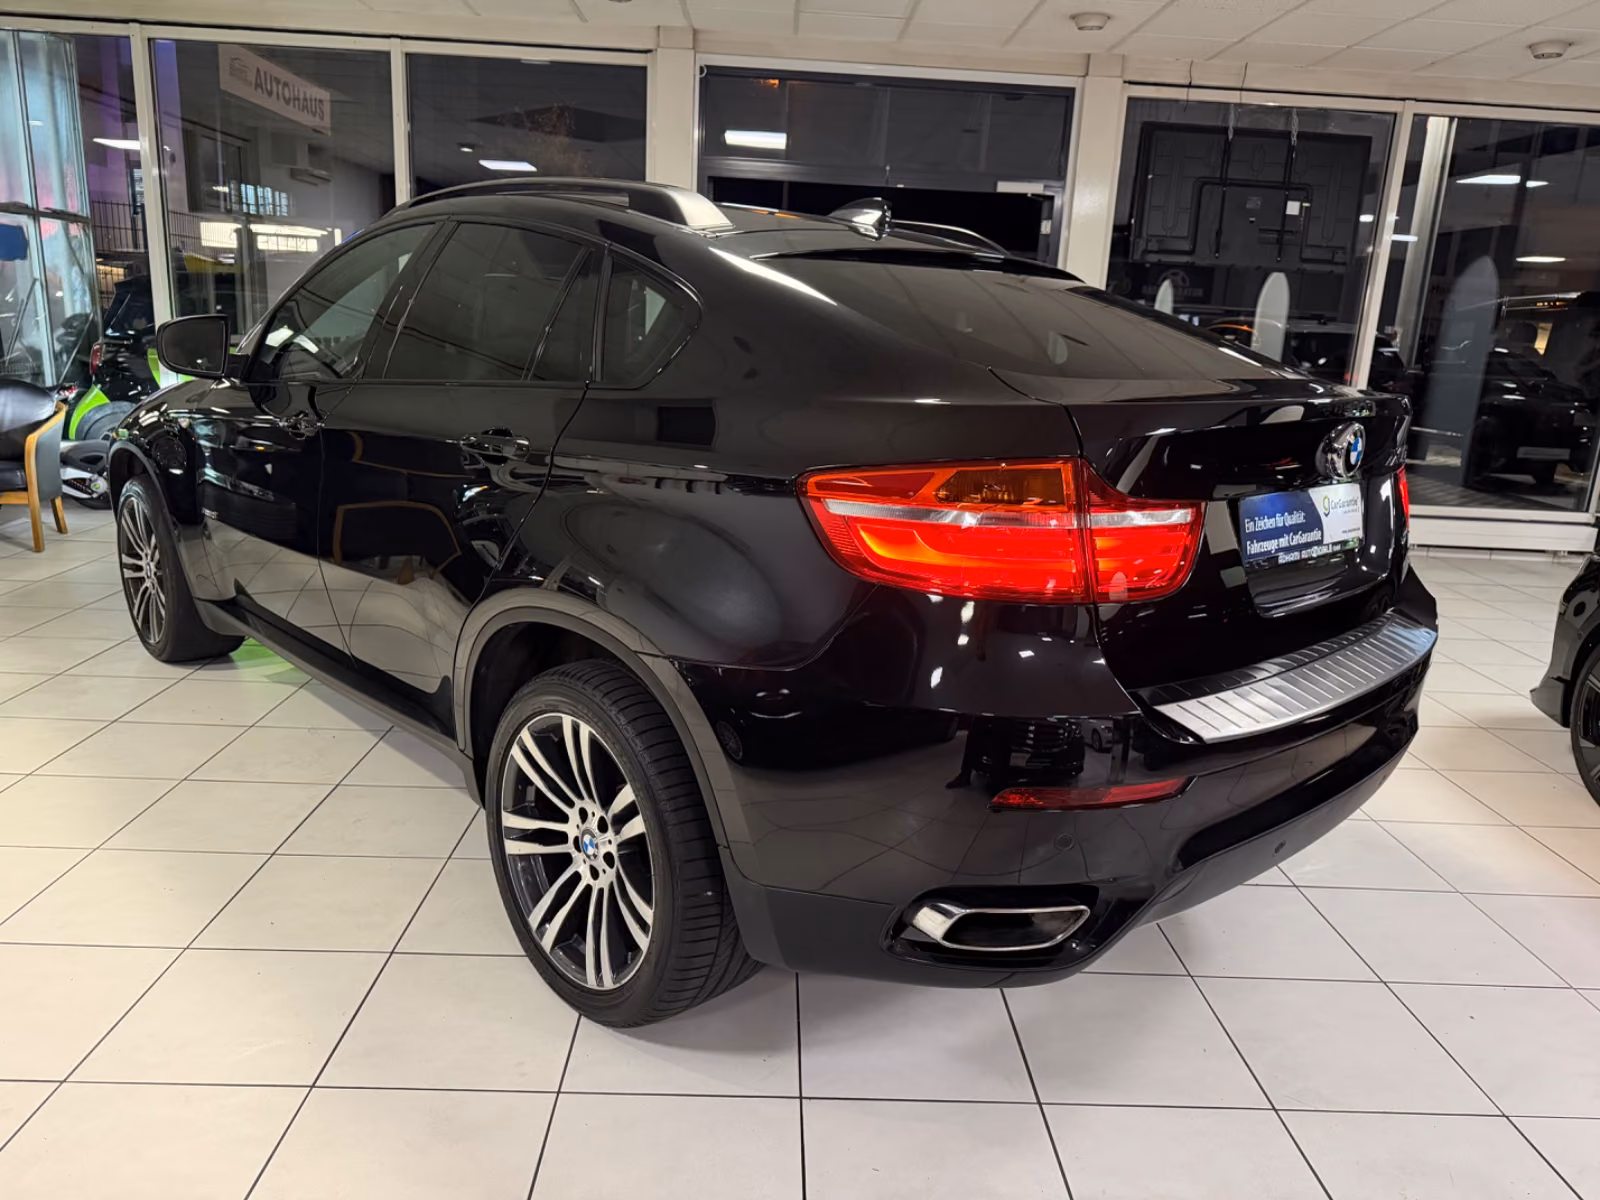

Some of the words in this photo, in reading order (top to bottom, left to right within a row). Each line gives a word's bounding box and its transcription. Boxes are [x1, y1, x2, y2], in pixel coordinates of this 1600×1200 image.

[254, 66, 325, 121] AUTOHAUS
[1245, 518, 1255, 533] Ein
[1254, 514, 1276, 531] Zeichen
[1275, 512, 1284, 527] für
[1246, 539, 1279, 555] Fahrzeuge
[1279, 533, 1290, 549] mit
[1289, 527, 1322, 546] CarGarantie
